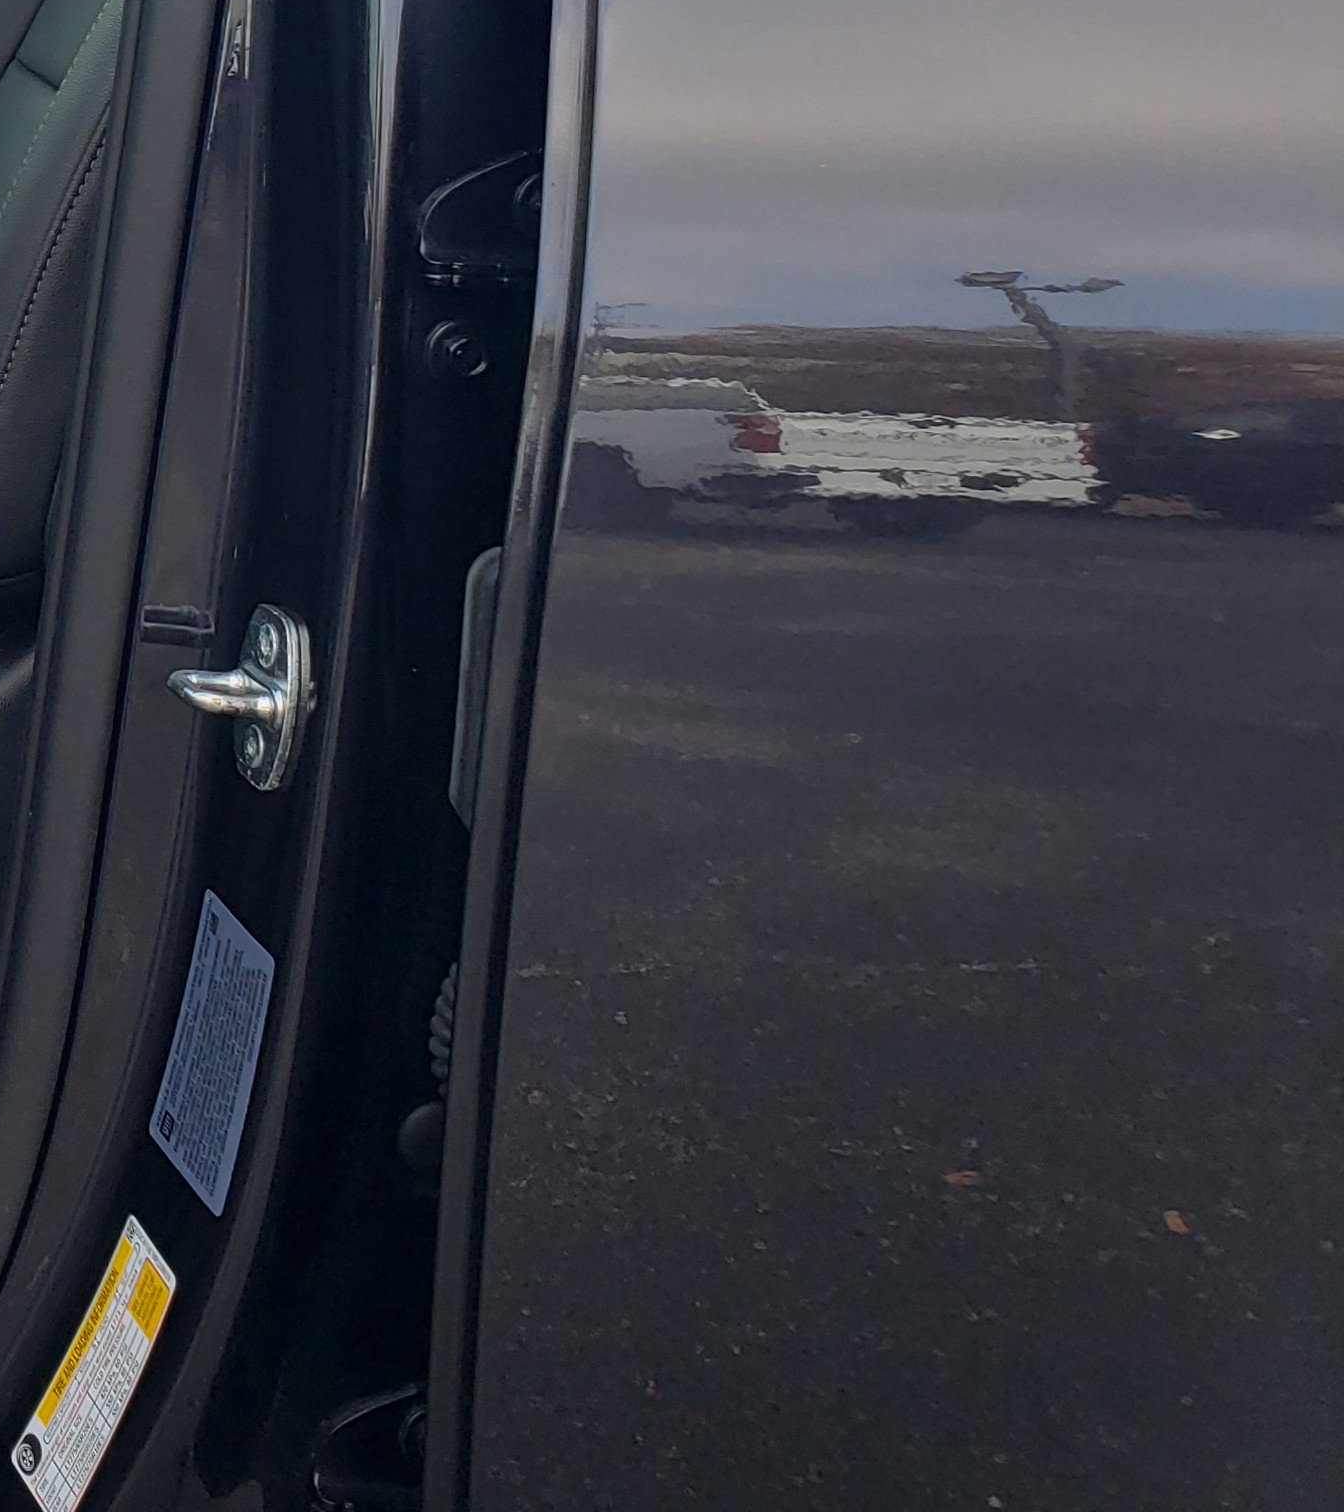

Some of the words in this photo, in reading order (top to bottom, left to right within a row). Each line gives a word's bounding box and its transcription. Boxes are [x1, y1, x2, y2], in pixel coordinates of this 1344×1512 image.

[52, 1375, 66, 1399] TIRE
[62, 1356, 76, 1380] AND
[71, 1321, 93, 1363] LOADING
[89, 1266, 118, 1325] INFORMATION
[92, 1369, 103, 1390] COLD
